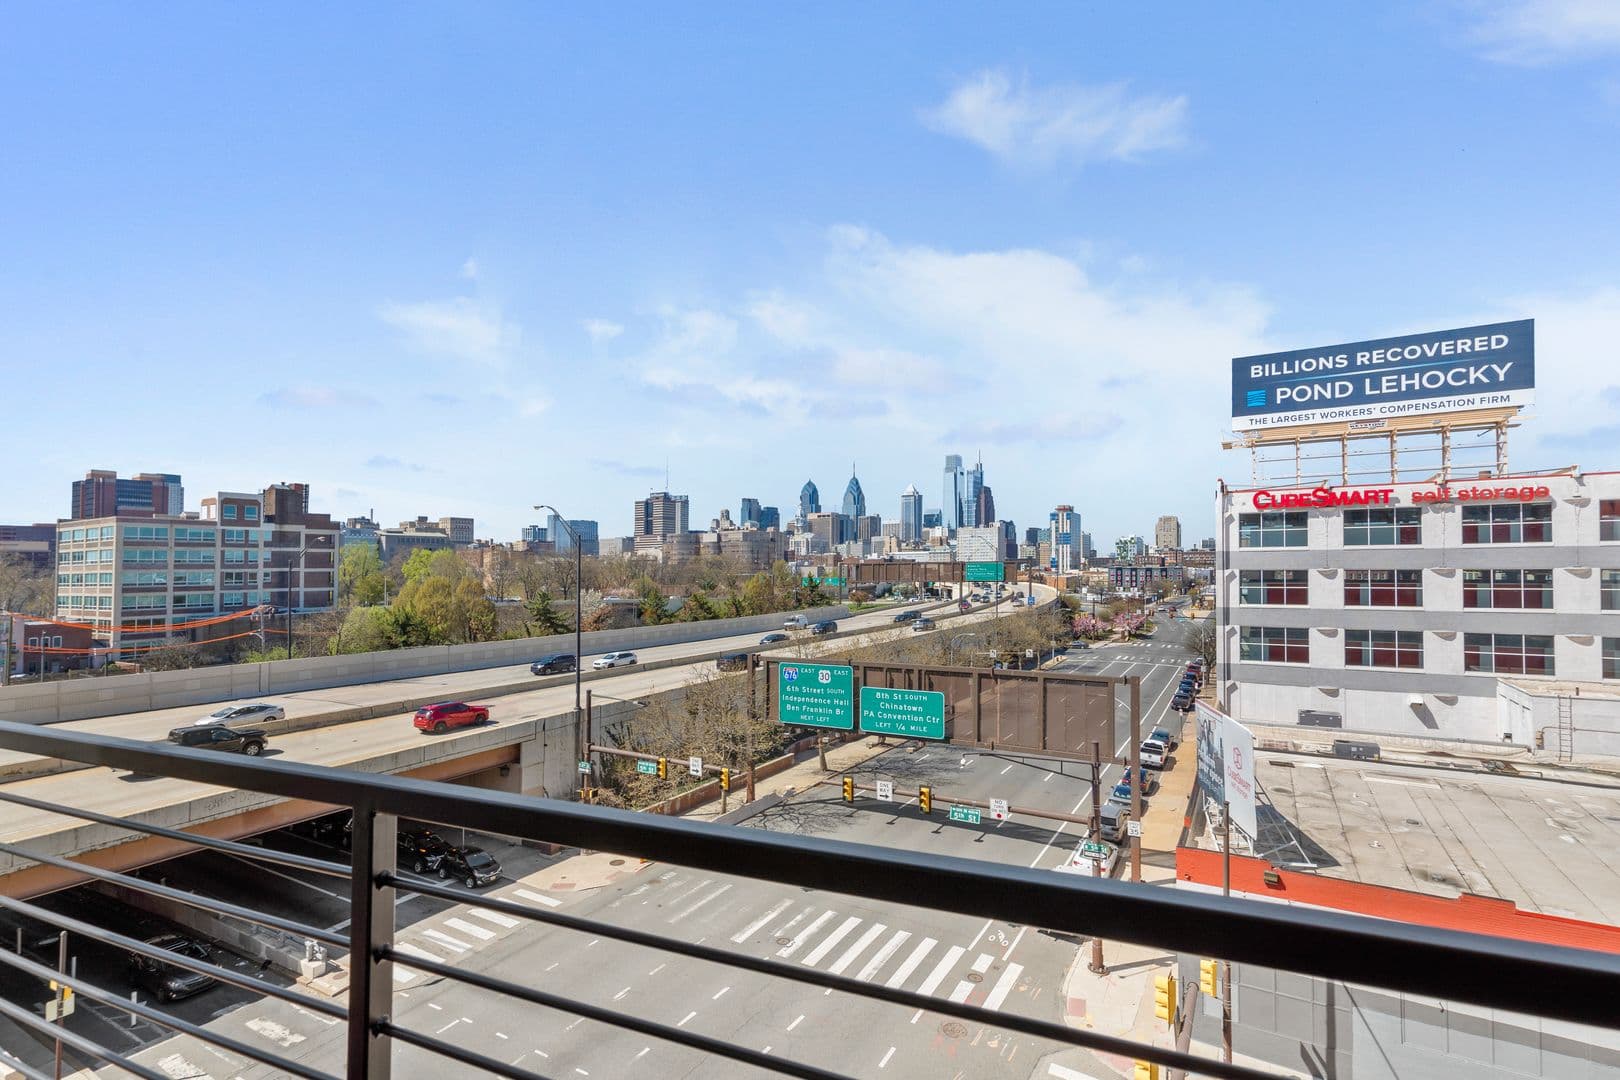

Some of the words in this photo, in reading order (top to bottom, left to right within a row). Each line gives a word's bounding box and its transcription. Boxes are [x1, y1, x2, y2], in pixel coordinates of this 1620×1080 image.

[1250, 354, 1348, 378] BILLIONS
[1356, 334, 1509, 366] RECOVERED
[1276, 381, 1354, 404] POND
[1365, 362, 1514, 396] LEHOCKY
[1249, 417, 1268, 426] THE
[1270, 412, 1316, 425] LARGEST
[1380, 398, 1476, 414] COMPENSATION
[1480, 394, 1511, 405] FIRM
[1411, 487, 1451, 503] self
[1458, 486, 1550, 502] storage
[784, 670, 797, 680] 676
[819, 672, 830, 681] 30
[782, 694, 831, 705] Independence
[833, 698, 849, 706] Hall
[802, 705, 833, 714] Franklin
[880, 702, 923, 712] Chinatown
[877, 712, 923, 722] Convention
[926, 716, 940, 724] Ctr
[968, 815, 977, 823] St
